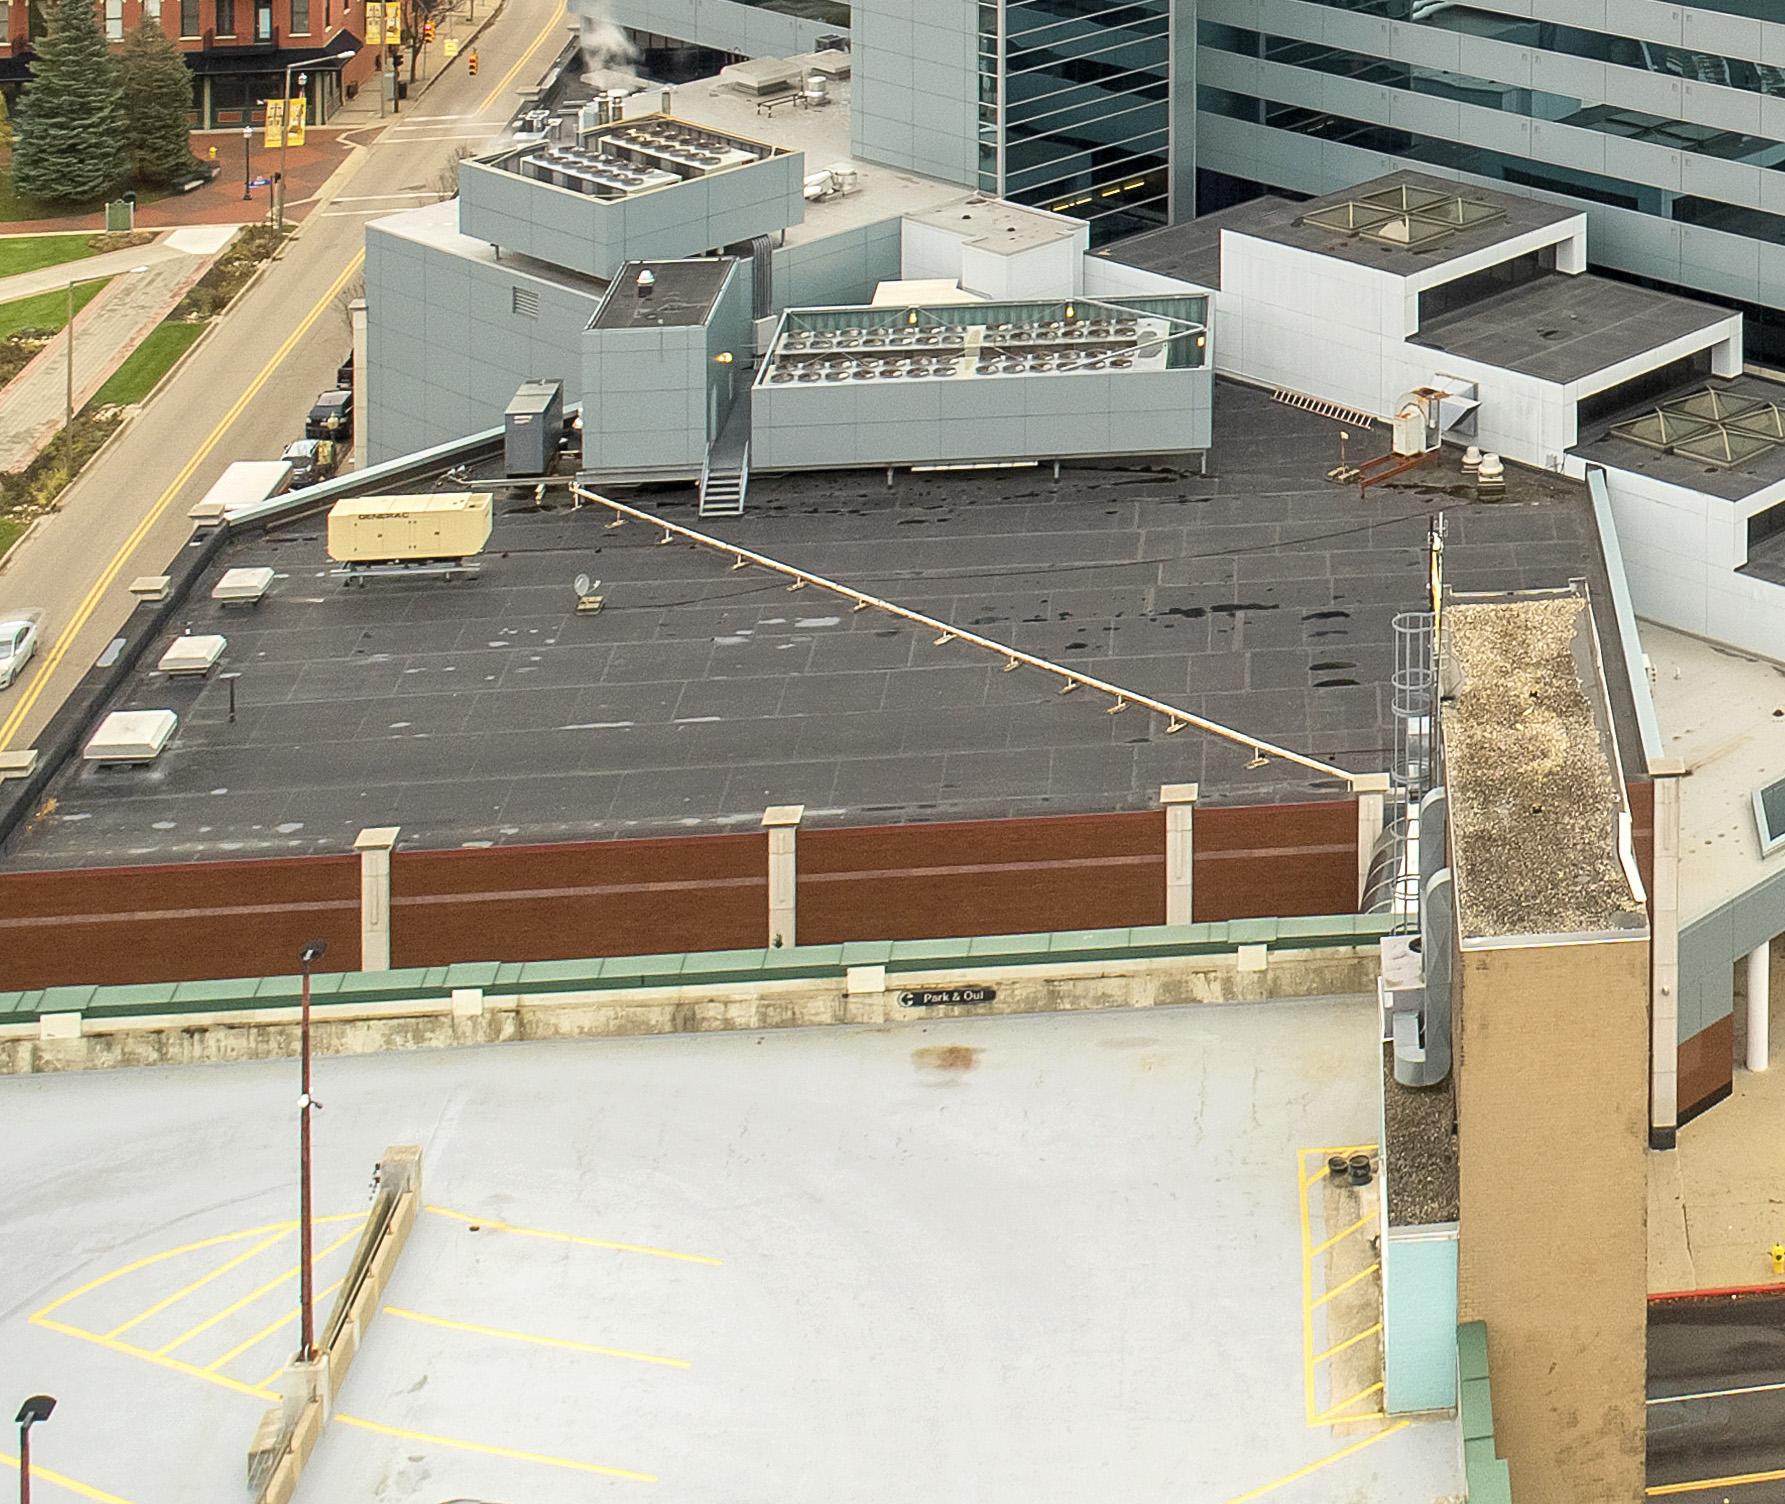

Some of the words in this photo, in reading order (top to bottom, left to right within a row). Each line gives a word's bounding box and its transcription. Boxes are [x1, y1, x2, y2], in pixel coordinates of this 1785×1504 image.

[358, 512, 410, 520] GENERAC
[923, 992, 949, 1003] Park
[952, 992, 960, 1002] &
